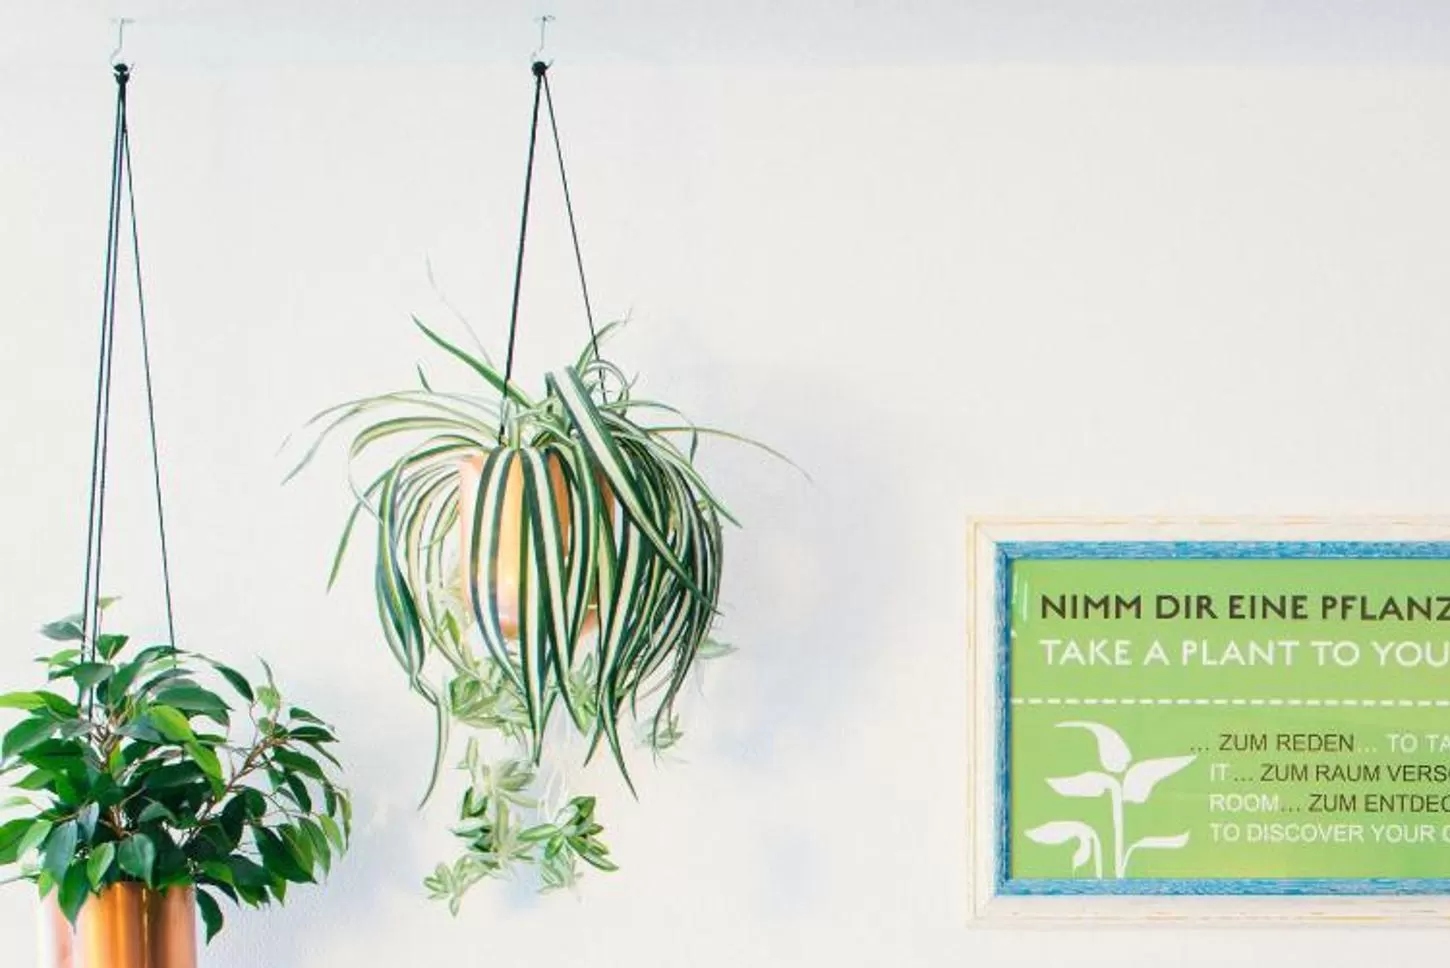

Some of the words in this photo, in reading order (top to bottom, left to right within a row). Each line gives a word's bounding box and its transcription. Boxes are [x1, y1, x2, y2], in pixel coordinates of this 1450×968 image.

[1041, 594, 1143, 620] NIMM
[1155, 595, 1219, 620] DIR
[1229, 595, 1308, 620] EINE
[1039, 639, 1133, 667] TAKE
[1142, 639, 1171, 667] A
[1181, 639, 1300, 667] PLANT
[1309, 640, 1361, 667] TO
[1219, 733, 1268, 752] ZUM
[1386, 734, 1418, 753] TO
[1260, 763, 1308, 783] ZUM
[1315, 763, 1381, 783] RAUM
[1308, 794, 1356, 813] ZUM
[1209, 823, 1240, 843] TO
[1247, 823, 1365, 843] DISCOVER
[1370, 823, 1435, 843] YOUR
